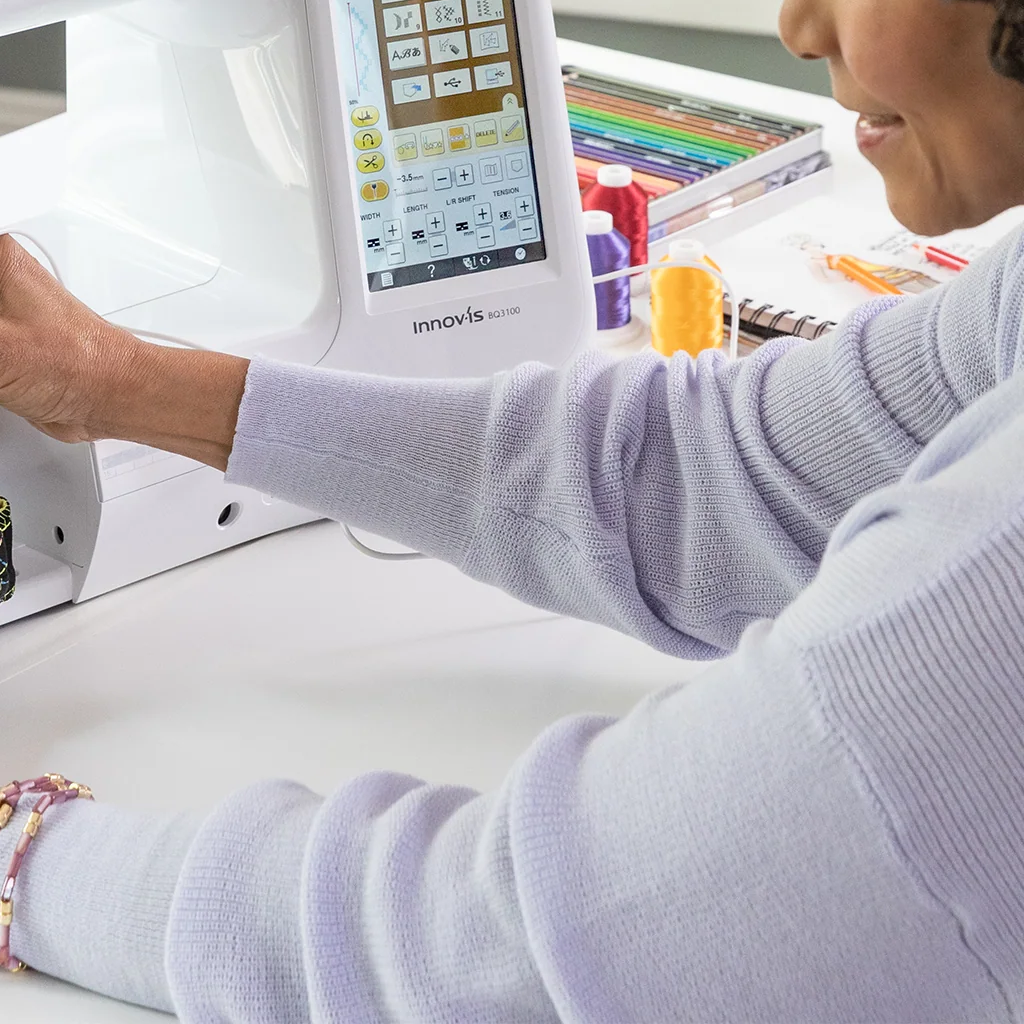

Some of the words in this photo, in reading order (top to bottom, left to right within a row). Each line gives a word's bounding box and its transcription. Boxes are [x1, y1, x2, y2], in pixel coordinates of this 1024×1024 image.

[493, 187, 519, 196] TENSION
[458, 195, 476, 203] SHIFT
[403, 204, 428, 213] LENGTH
[360, 212, 381, 221] WIDTH
[488, 307, 520, 319] BQ3100
